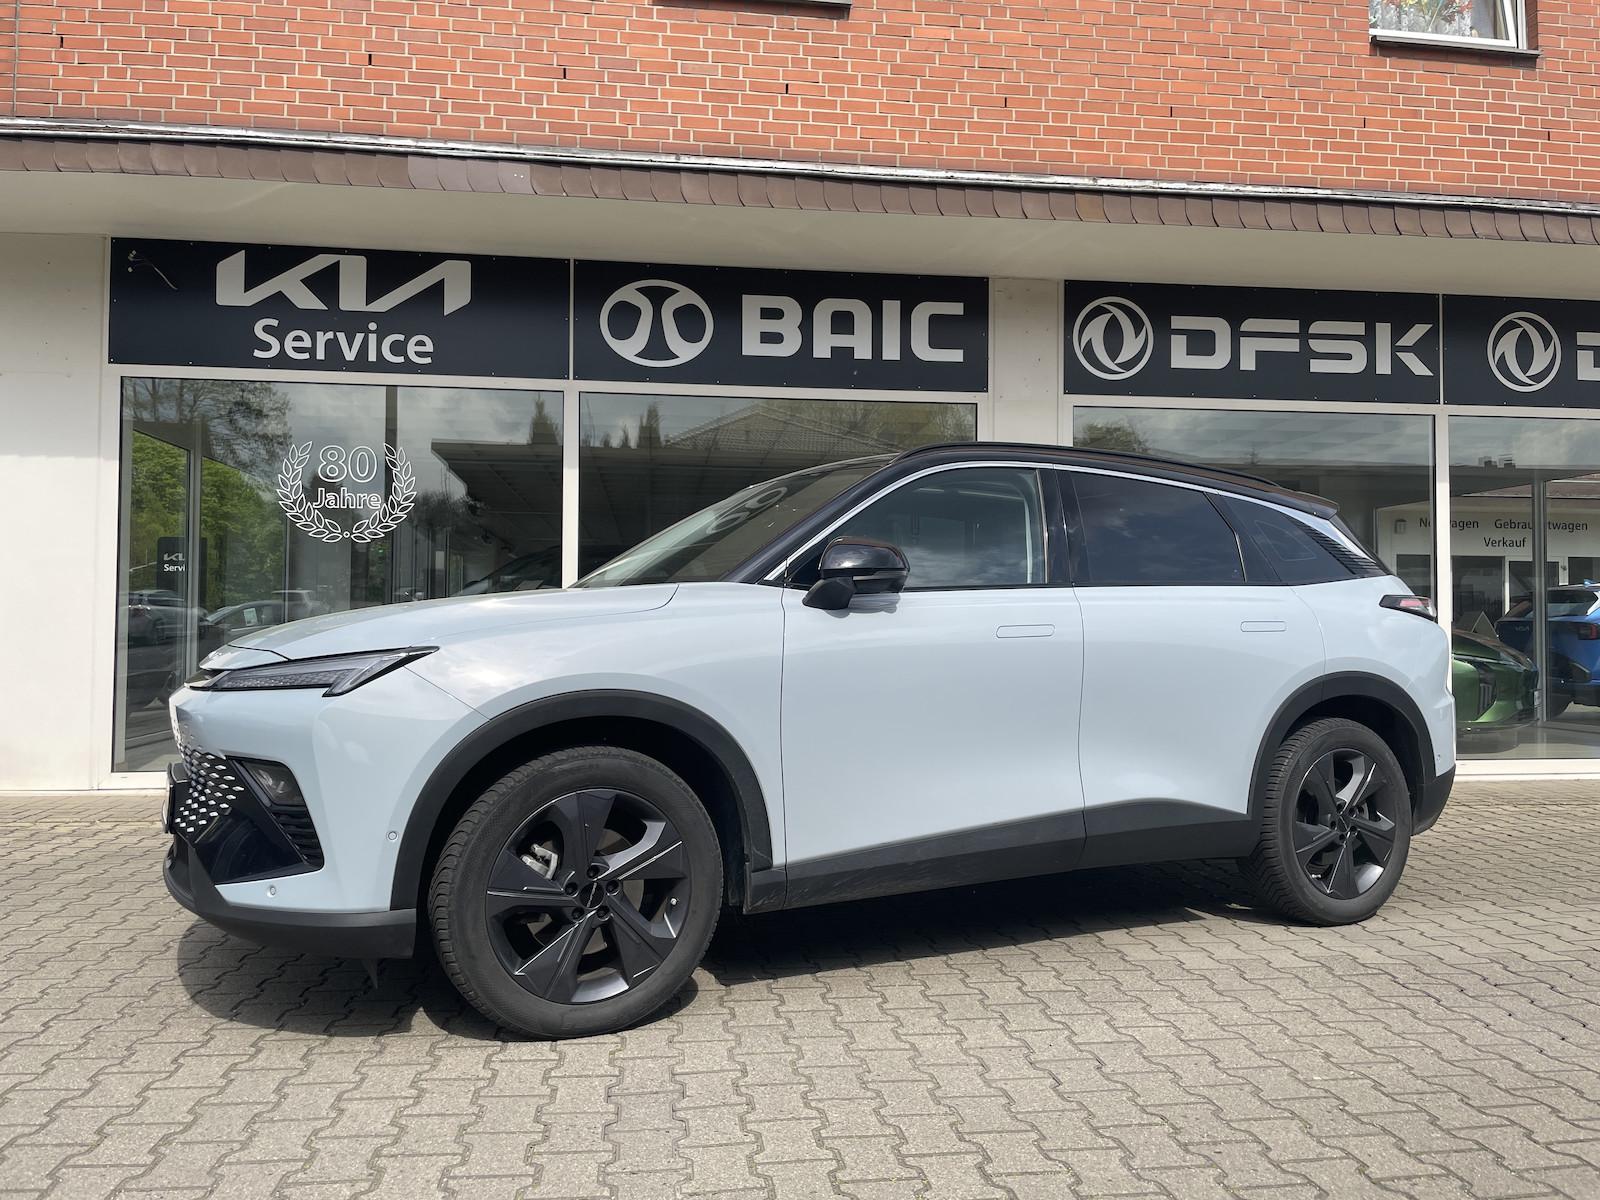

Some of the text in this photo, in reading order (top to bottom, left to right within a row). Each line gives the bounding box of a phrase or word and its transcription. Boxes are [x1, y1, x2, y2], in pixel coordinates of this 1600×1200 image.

[216, 250, 472, 316] KIA
[253, 318, 434, 364] Service
[742, 294, 964, 362] BAIC
[1170, 315, 1434, 376] DFSK
[318, 445, 377, 483] 80
[313, 487, 382, 509] Jahre
[1419, 517, 1588, 533] Nagen Gebrautwagen
[163, 552, 186, 561] KI
[1484, 537, 1527, 548] Verkauf
[163, 563, 186, 572] Servi
